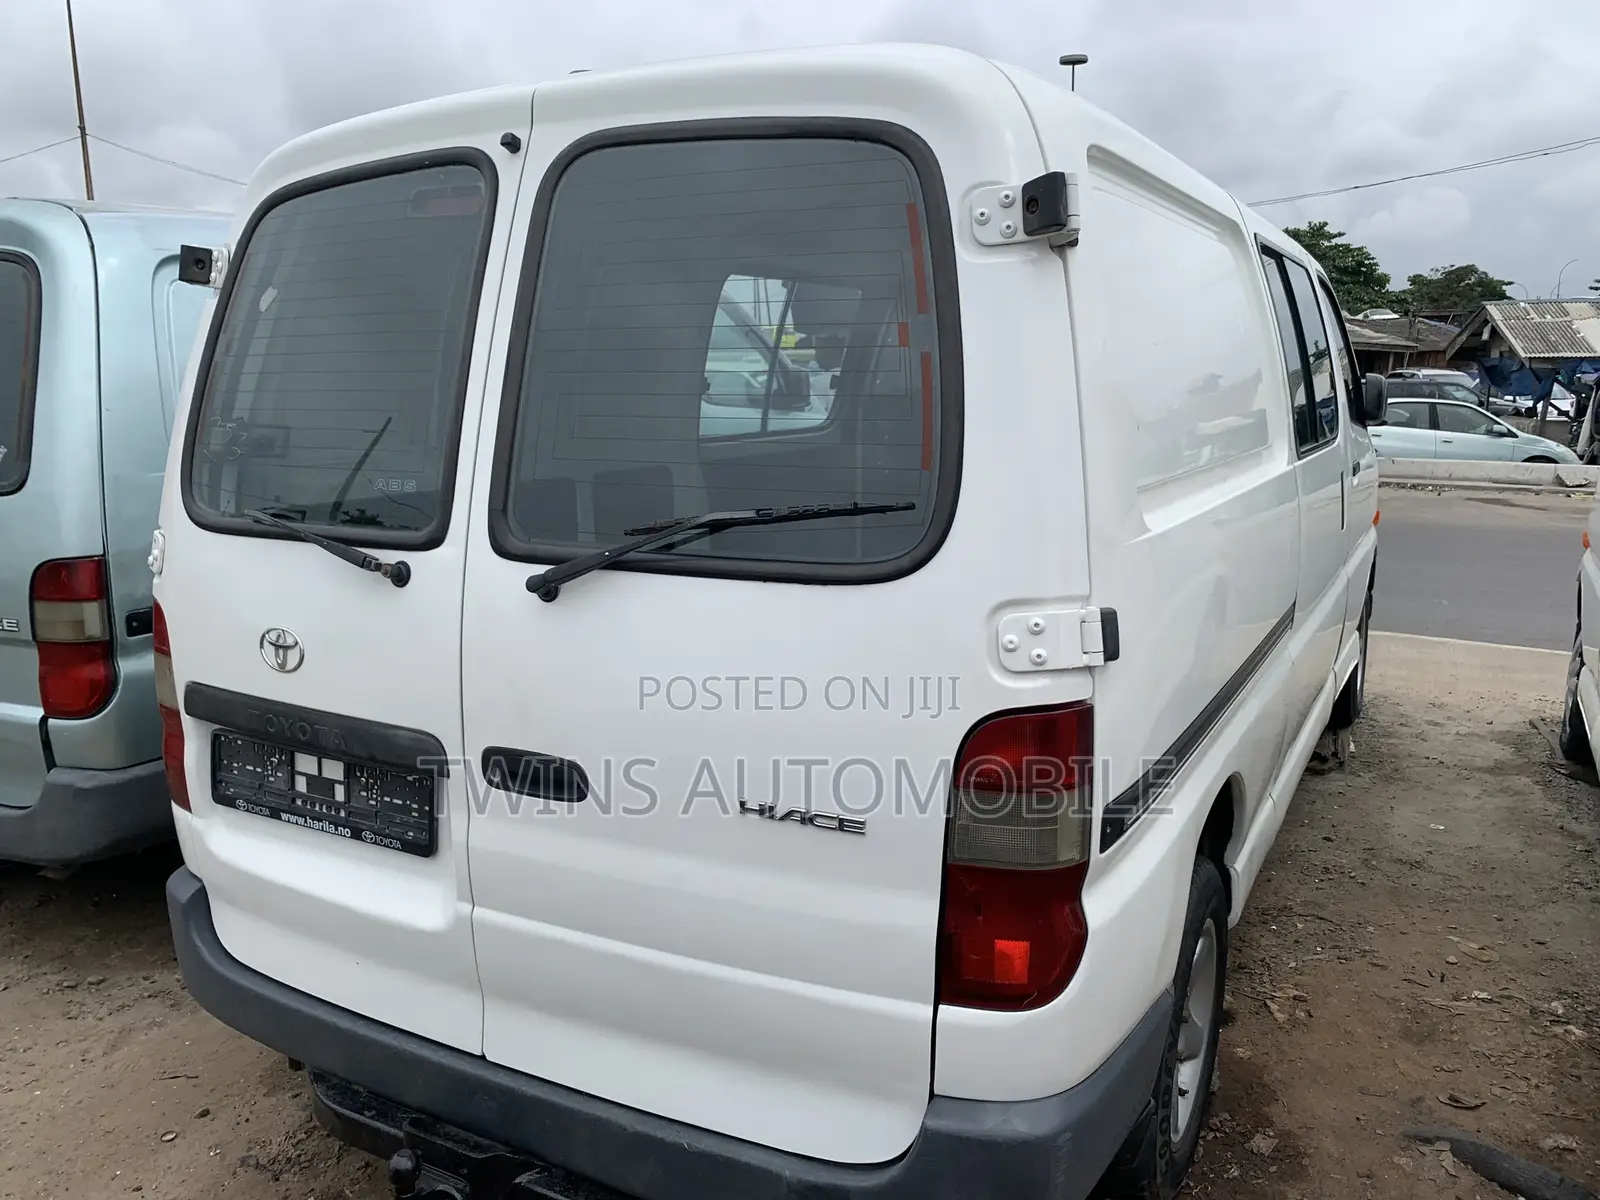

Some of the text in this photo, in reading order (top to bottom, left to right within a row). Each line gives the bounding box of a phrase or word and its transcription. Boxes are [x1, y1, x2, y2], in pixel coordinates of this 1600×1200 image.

[373, 479, 417, 492] ABS
[248, 708, 348, 750] TOYOTA
[247, 803, 271, 817] TOYOTA
[738, 796, 868, 836] HIACE
[280, 811, 352, 838] www.harila.no
[375, 834, 402, 850] TOYOTA
